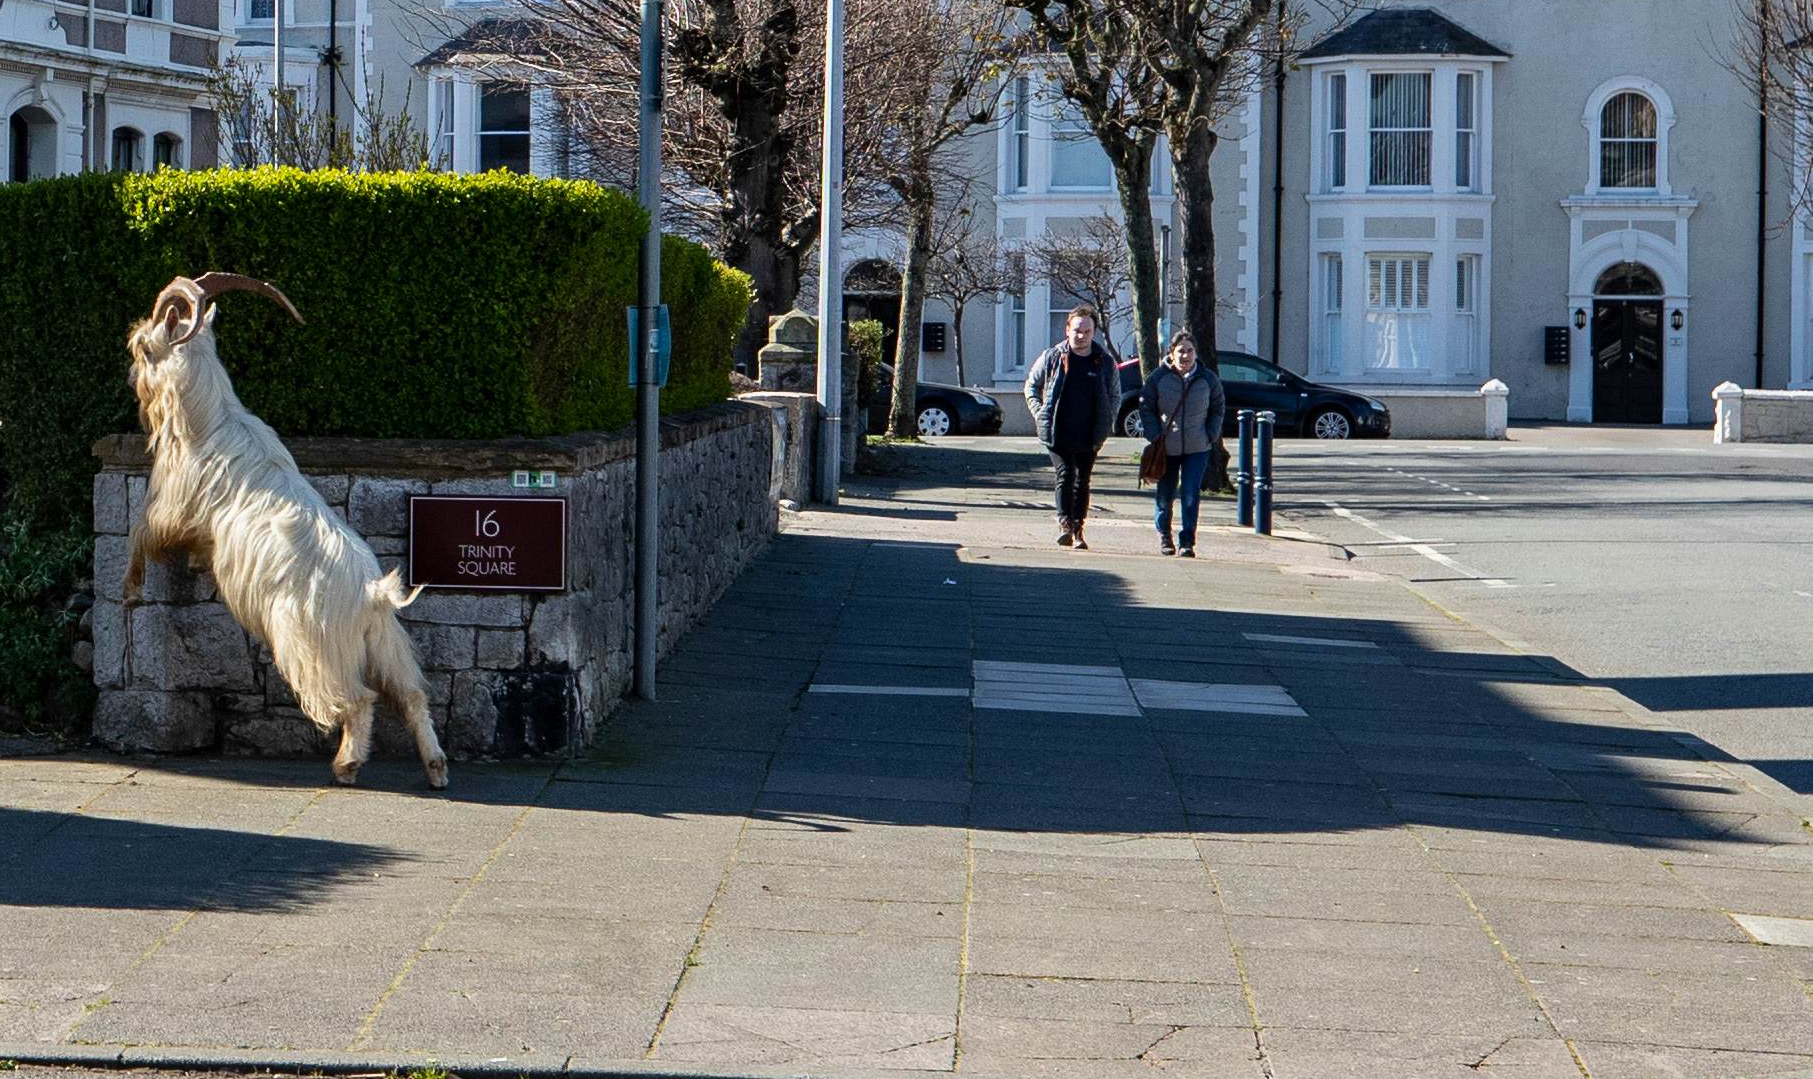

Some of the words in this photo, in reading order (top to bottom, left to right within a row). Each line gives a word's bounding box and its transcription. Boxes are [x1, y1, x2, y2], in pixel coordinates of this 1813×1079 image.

[475, 509, 500, 537] 16
[458, 544, 516, 559] TRINITY
[457, 560, 517, 577] SQUARE
